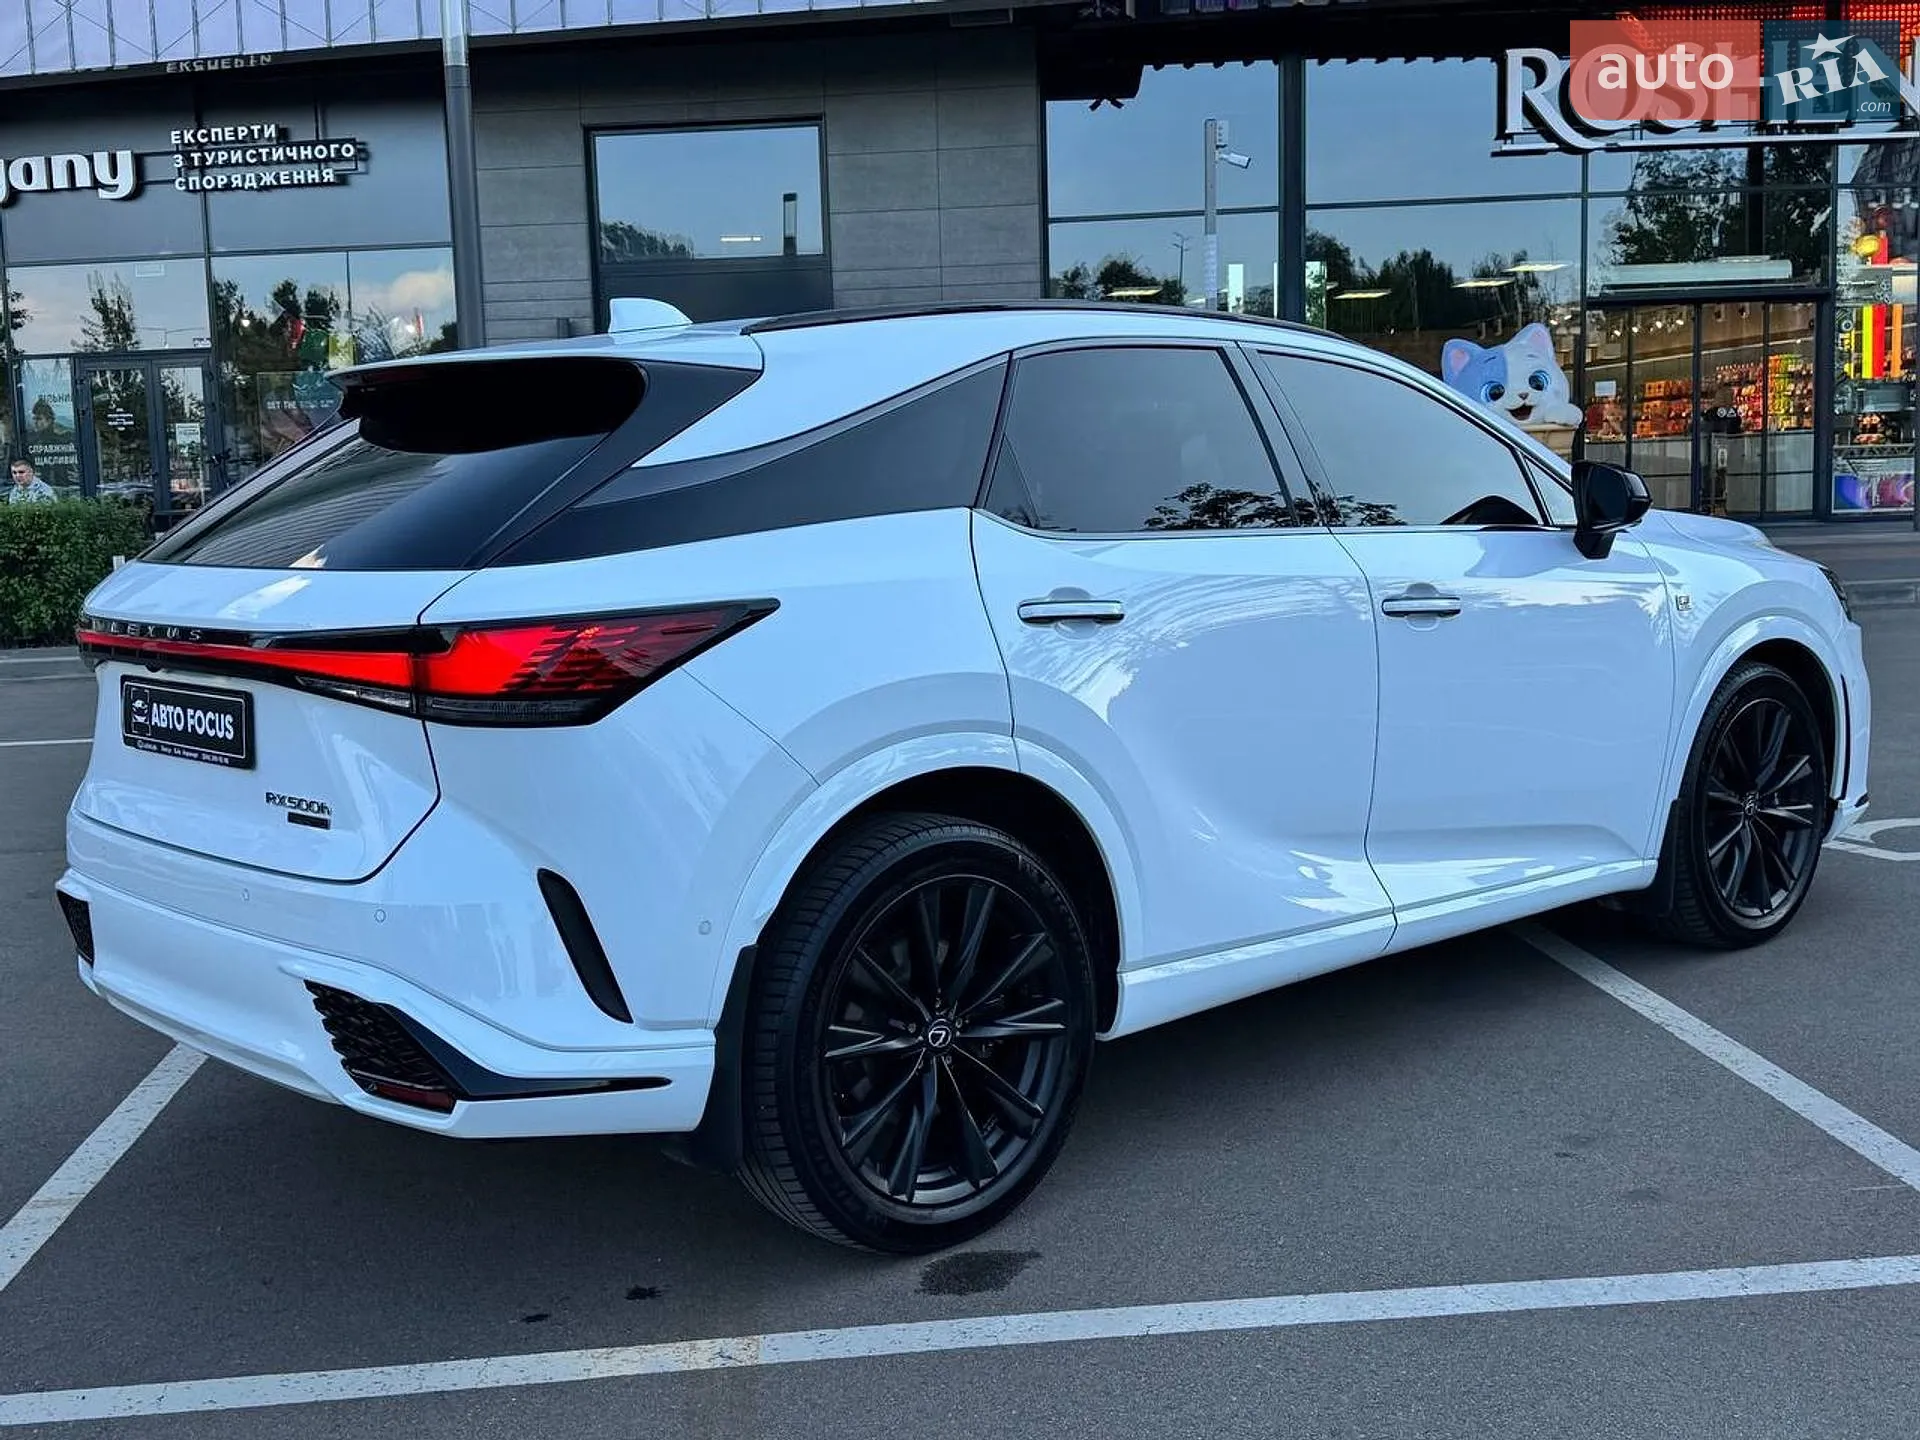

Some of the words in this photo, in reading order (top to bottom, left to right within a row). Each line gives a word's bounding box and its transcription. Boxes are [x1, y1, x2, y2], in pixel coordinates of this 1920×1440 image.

[171, 124, 276, 144] ЕКСПЕРТИ
[190, 143, 355, 167] ТУРИСТИЧНОГО
[175, 168, 335, 191] СПОРЯДЖЕННЯ
[110, 621, 201, 641] LEXUS
[187, 708, 234, 740] FOCUS
